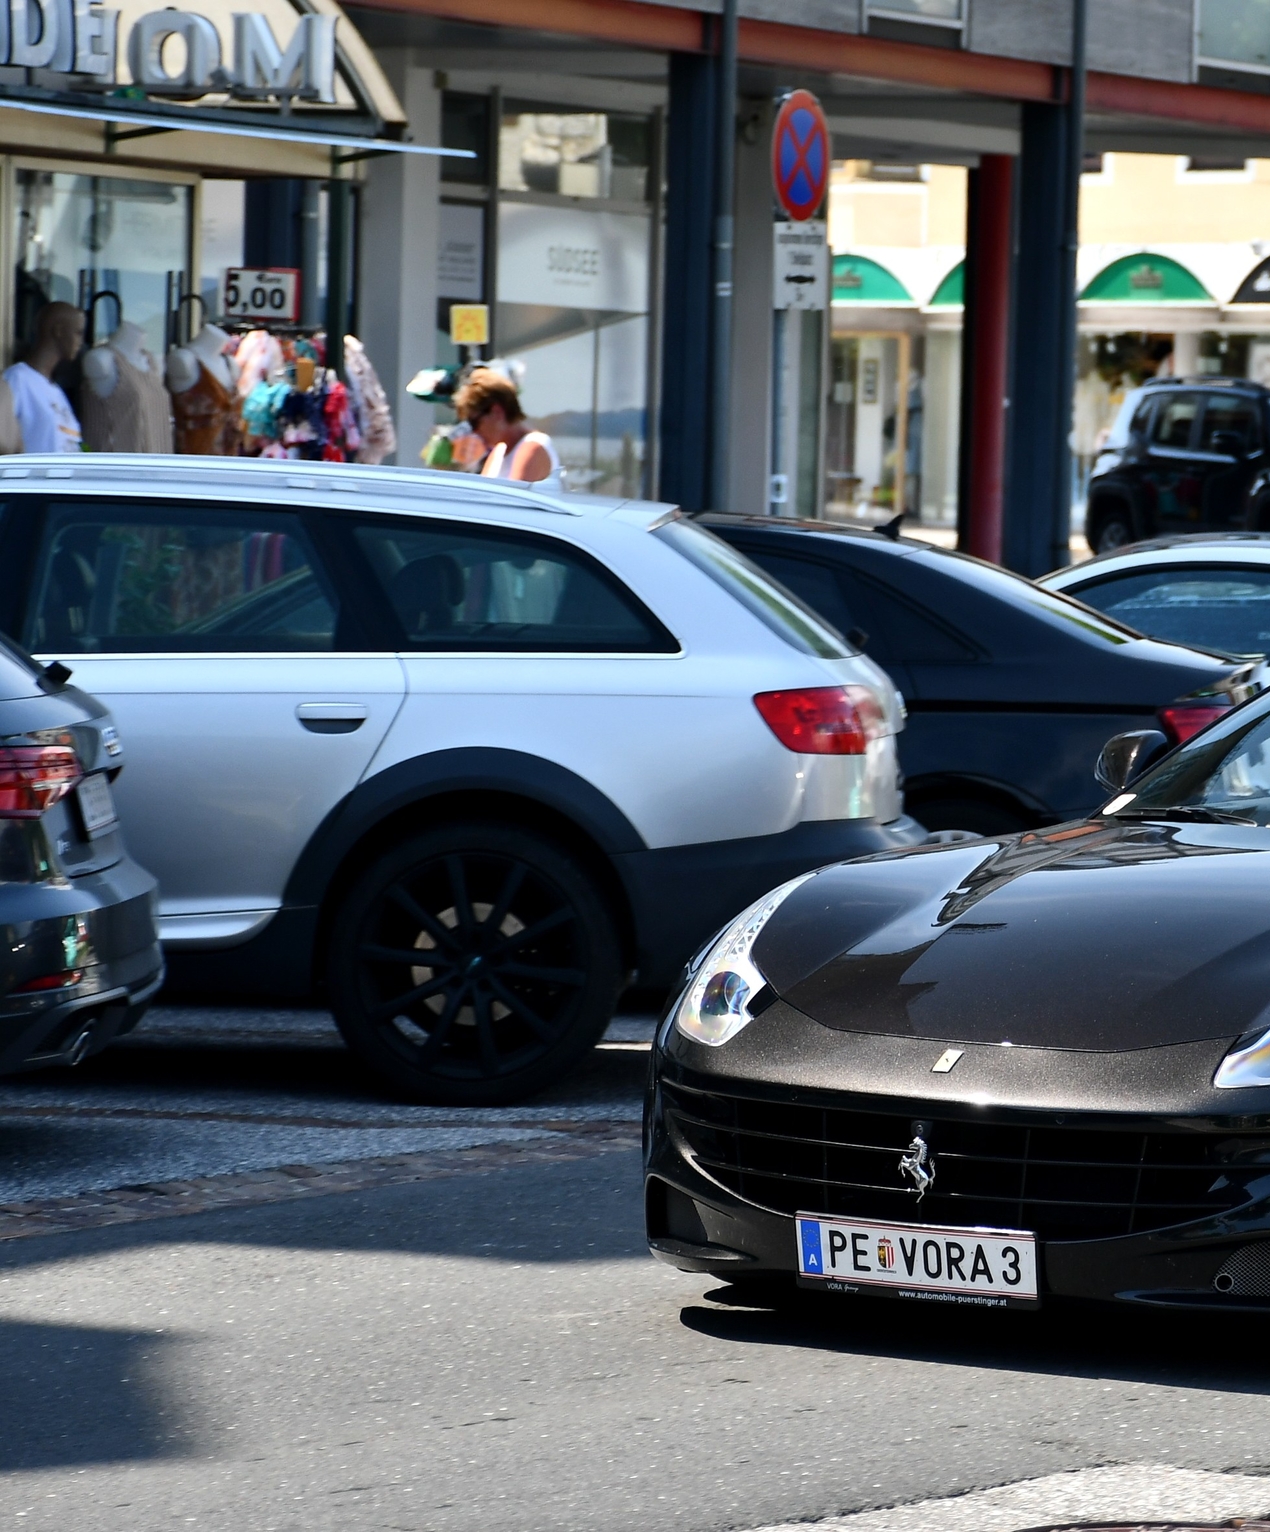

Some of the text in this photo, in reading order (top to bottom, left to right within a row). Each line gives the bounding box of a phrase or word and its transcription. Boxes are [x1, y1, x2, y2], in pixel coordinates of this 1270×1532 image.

[226, 273, 286, 312] 5,00
[808, 1253, 818, 1266] A
[828, 1230, 1021, 1285] PE VORA 3
[827, 1282, 843, 1290] VORA
[898, 1290, 1007, 1306] www.automobile-puerstinger.at
